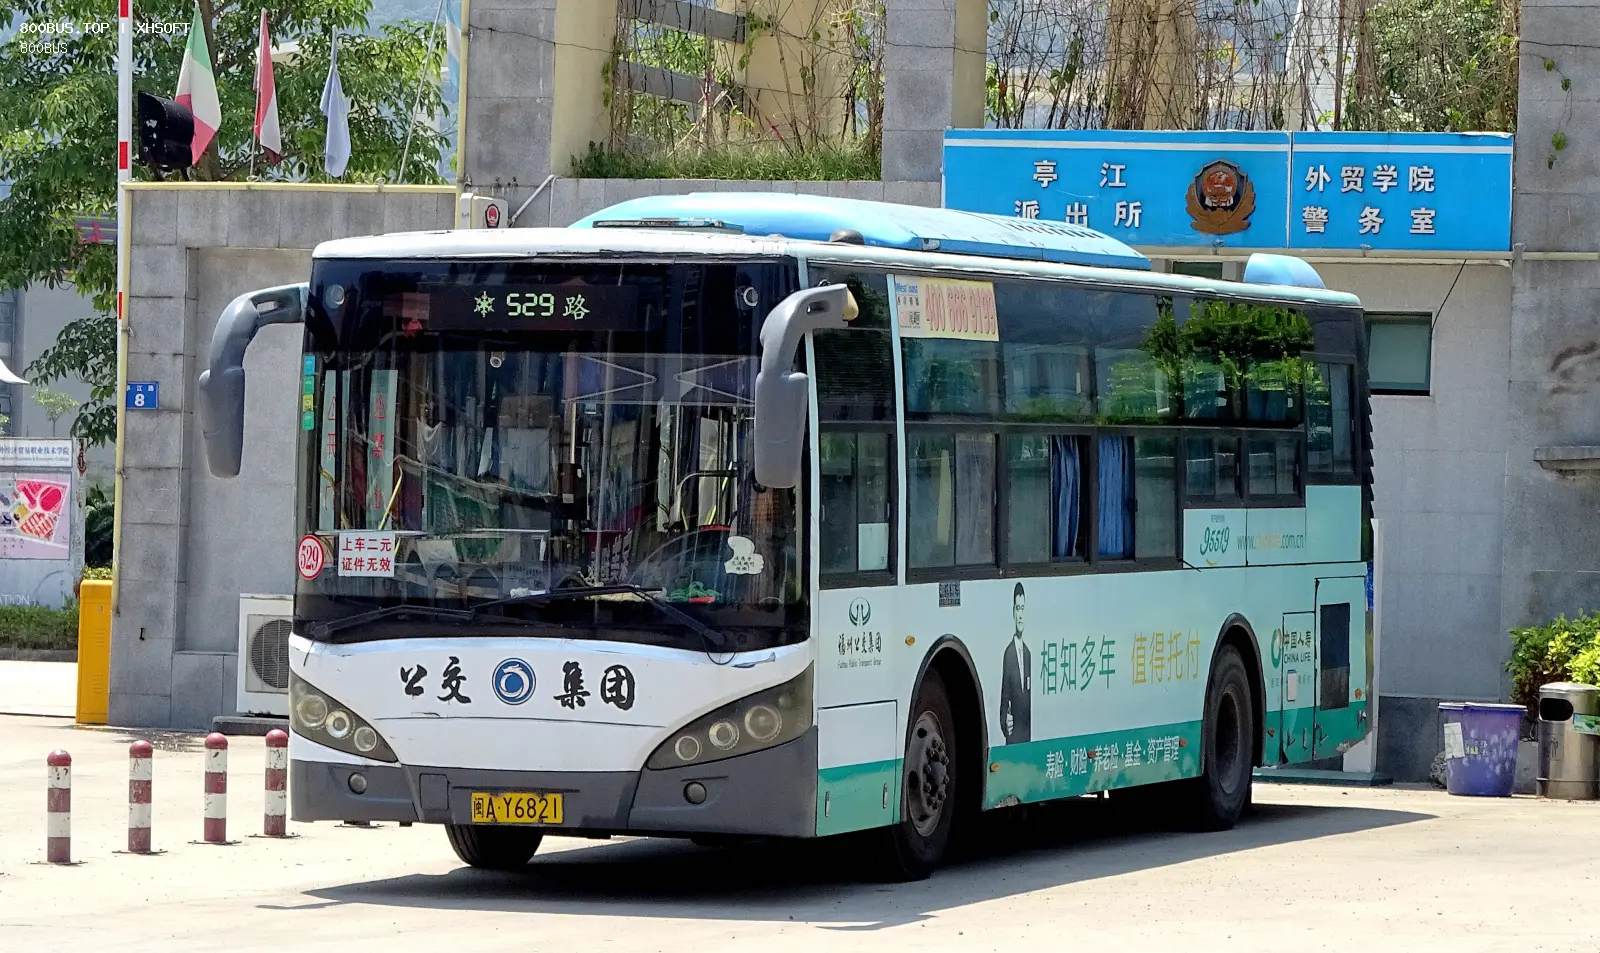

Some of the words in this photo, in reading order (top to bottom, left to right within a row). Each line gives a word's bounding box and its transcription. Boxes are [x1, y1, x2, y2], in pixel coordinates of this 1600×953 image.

[1033, 160, 1127, 188] 亭江
[1305, 165, 1435, 192] 外贸学院
[1014, 200, 1143, 228] 派出所
[1302, 206, 1436, 234] 警务室
[507, 293, 555, 316] 529
[563, 294, 590, 320] 路
[134, 393, 145, 407] 8
[342, 537, 392, 552] 上车二元
[1200, 526, 1230, 556] 95519
[300, 545, 319, 570] 529
[342, 557, 392, 572] 证件无效
[838, 631, 882, 656] 福州公交集团
[1283, 630, 1311, 651] 中国人寿
[1040, 635, 1116, 695] 相知多年
[1131, 628, 1200, 686] 值得托付
[1283, 654, 1299, 665] CHINA
[1300, 651, 1311, 663] LIFE
[400, 656, 471, 704] 公交
[553, 661, 635, 710] 集团
